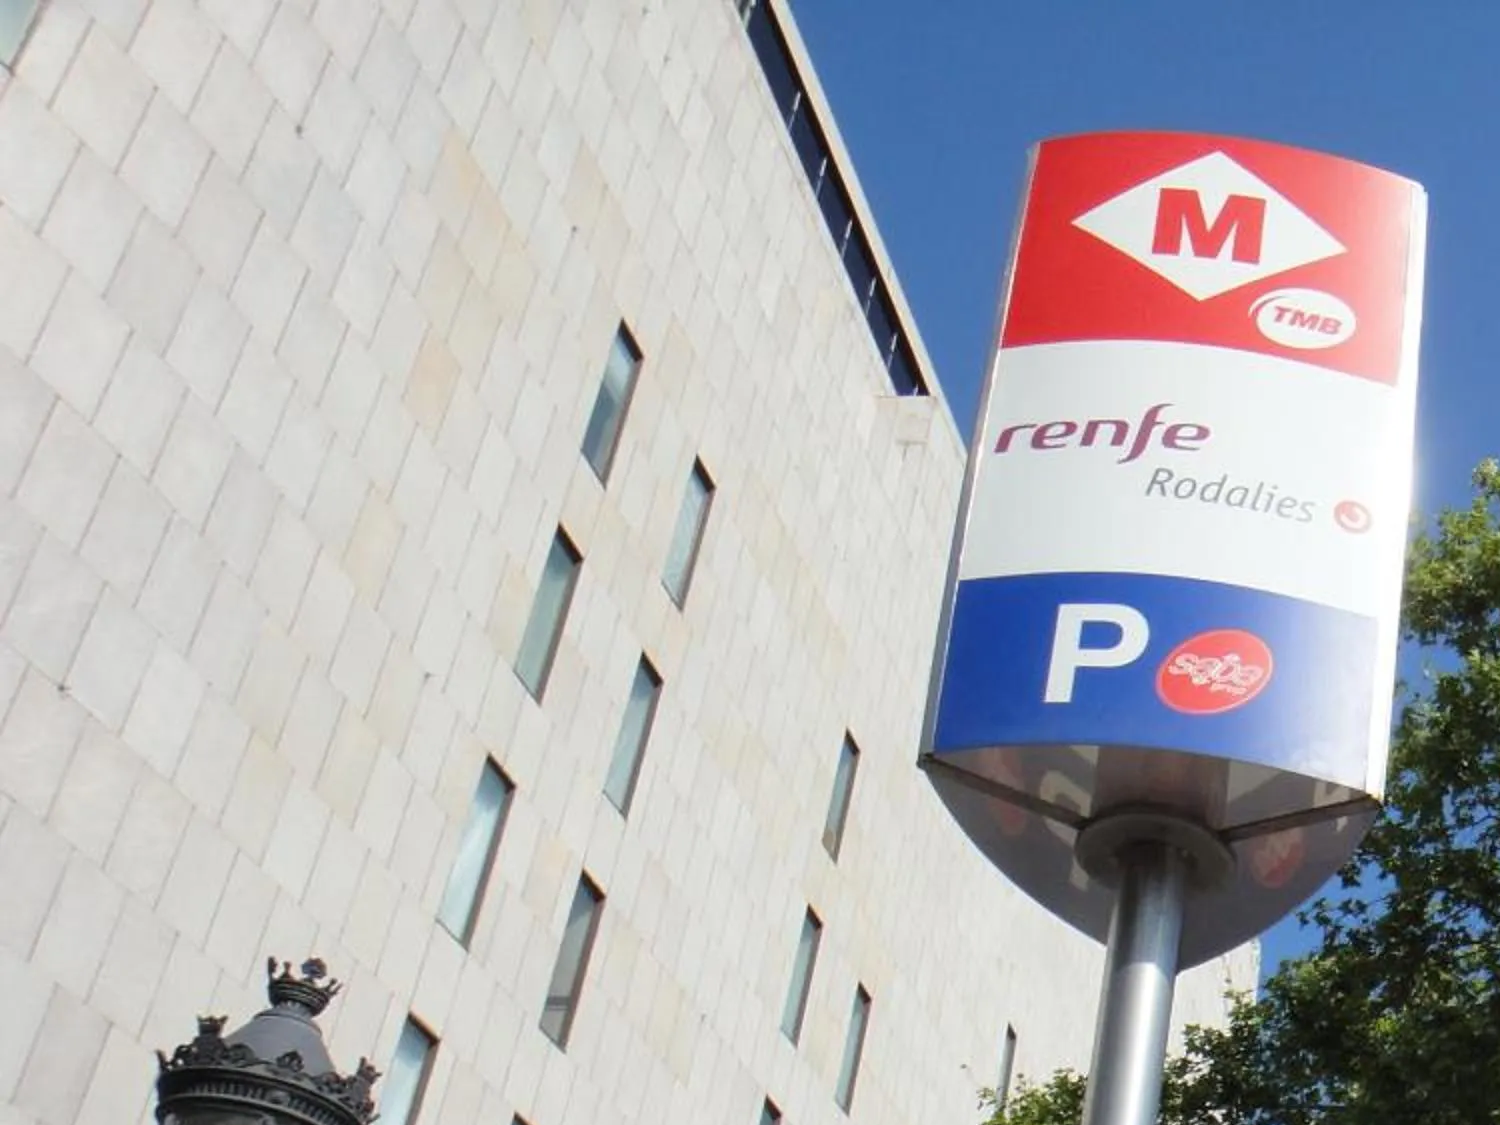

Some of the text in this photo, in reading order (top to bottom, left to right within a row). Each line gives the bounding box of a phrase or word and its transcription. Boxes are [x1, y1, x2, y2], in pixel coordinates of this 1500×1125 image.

[1152, 187, 1267, 266] M
[1272, 303, 1342, 336] TMB
[994, 403, 1211, 464] renfe
[1145, 467, 1316, 524] Rodalies
[1044, 603, 1150, 704] P
